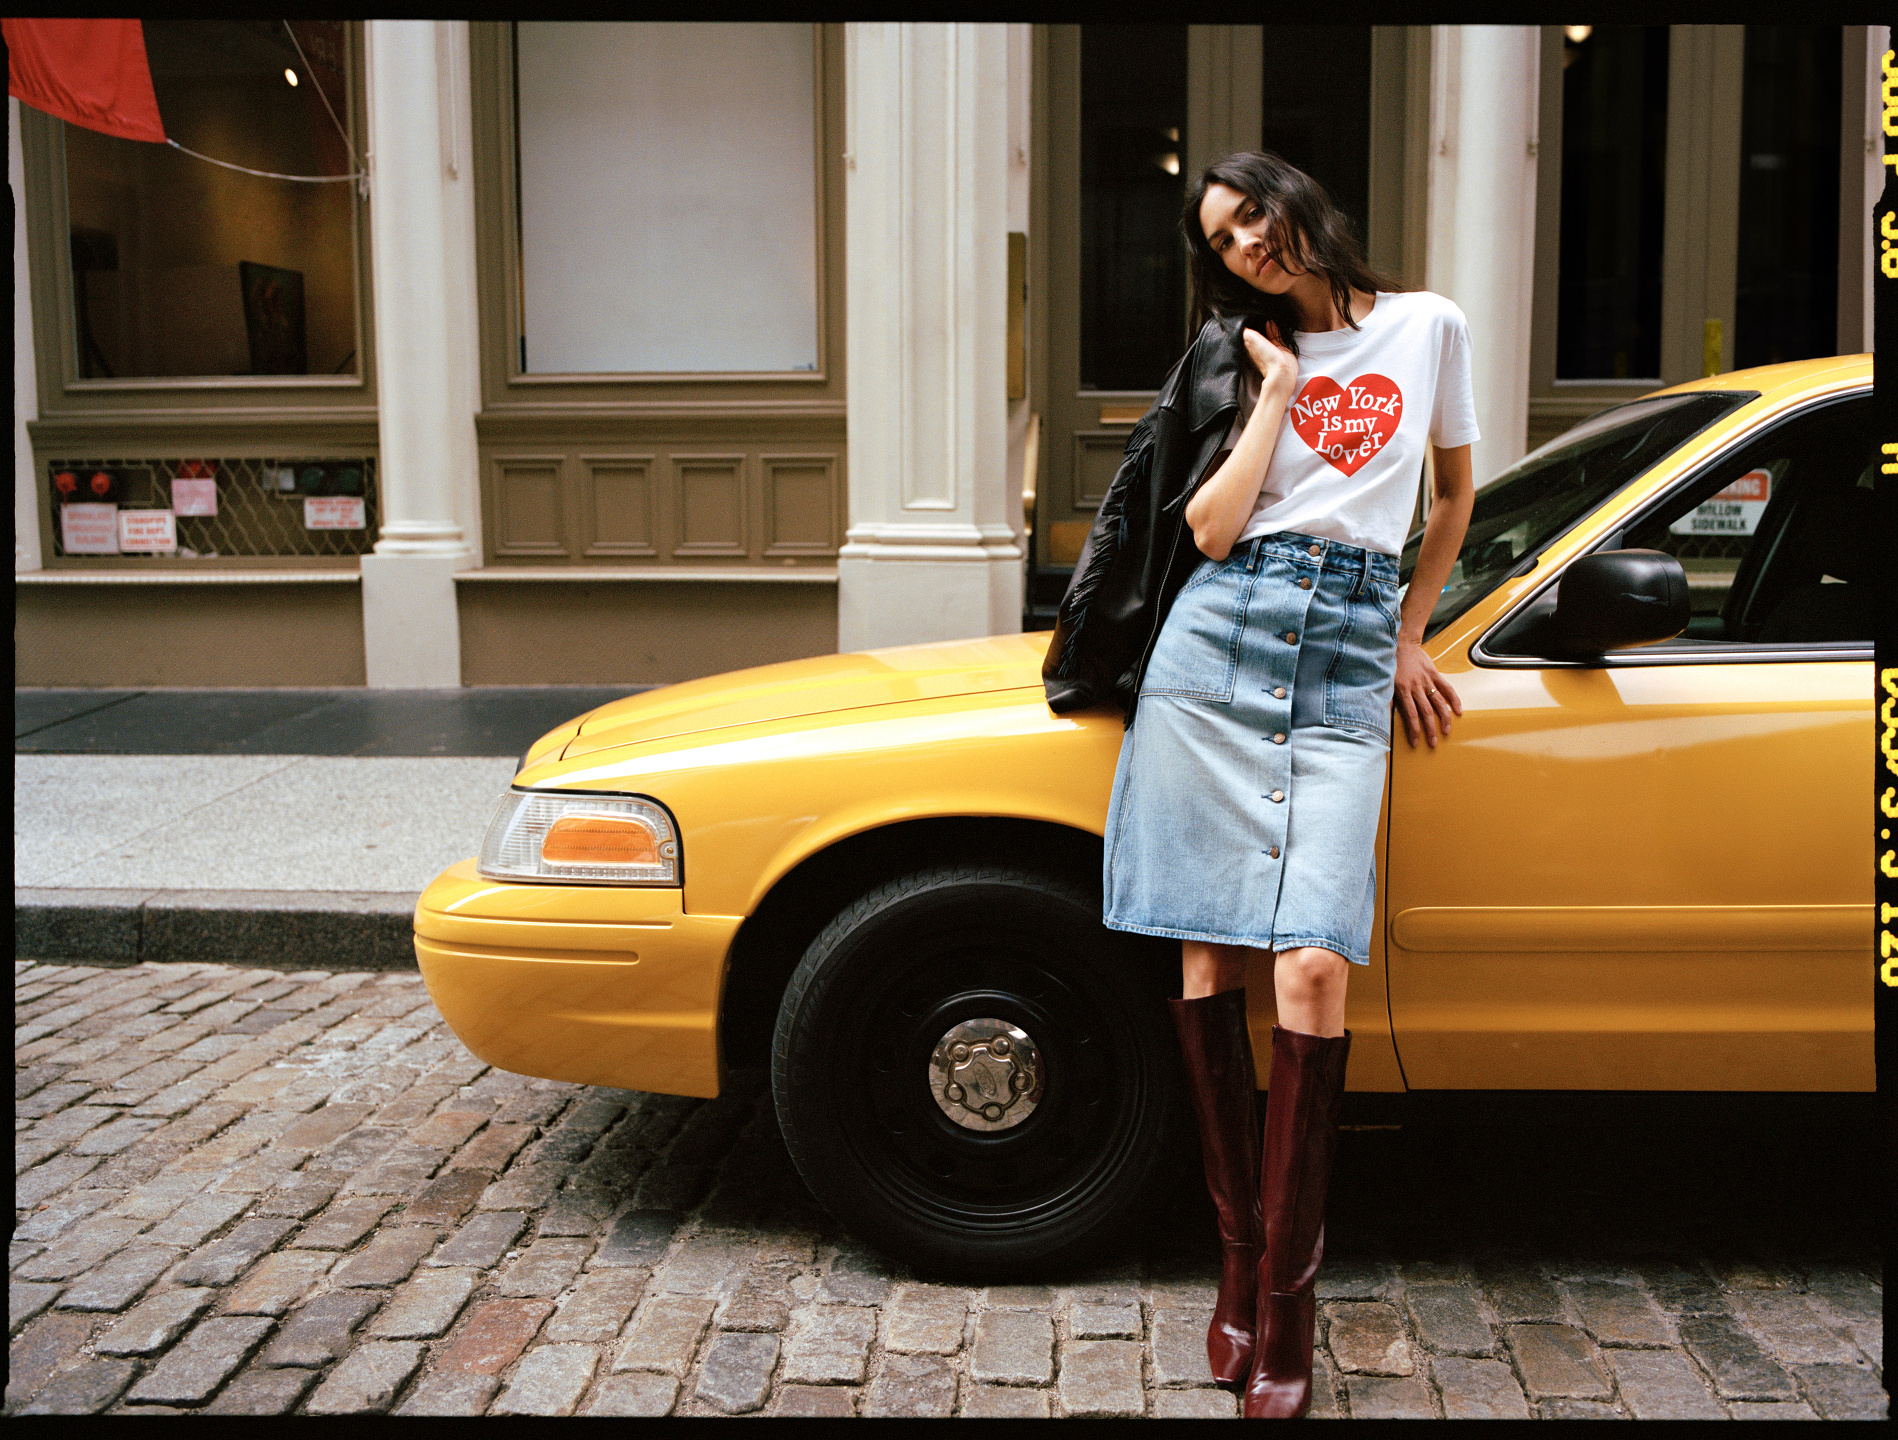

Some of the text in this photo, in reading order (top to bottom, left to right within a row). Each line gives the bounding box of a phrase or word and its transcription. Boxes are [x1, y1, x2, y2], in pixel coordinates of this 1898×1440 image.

[1293, 386, 1401, 426] New York
[1321, 411, 1378, 440] is my
[1314, 431, 1383, 465] Lover
[1691, 518, 1747, 531] SIDEWALK
